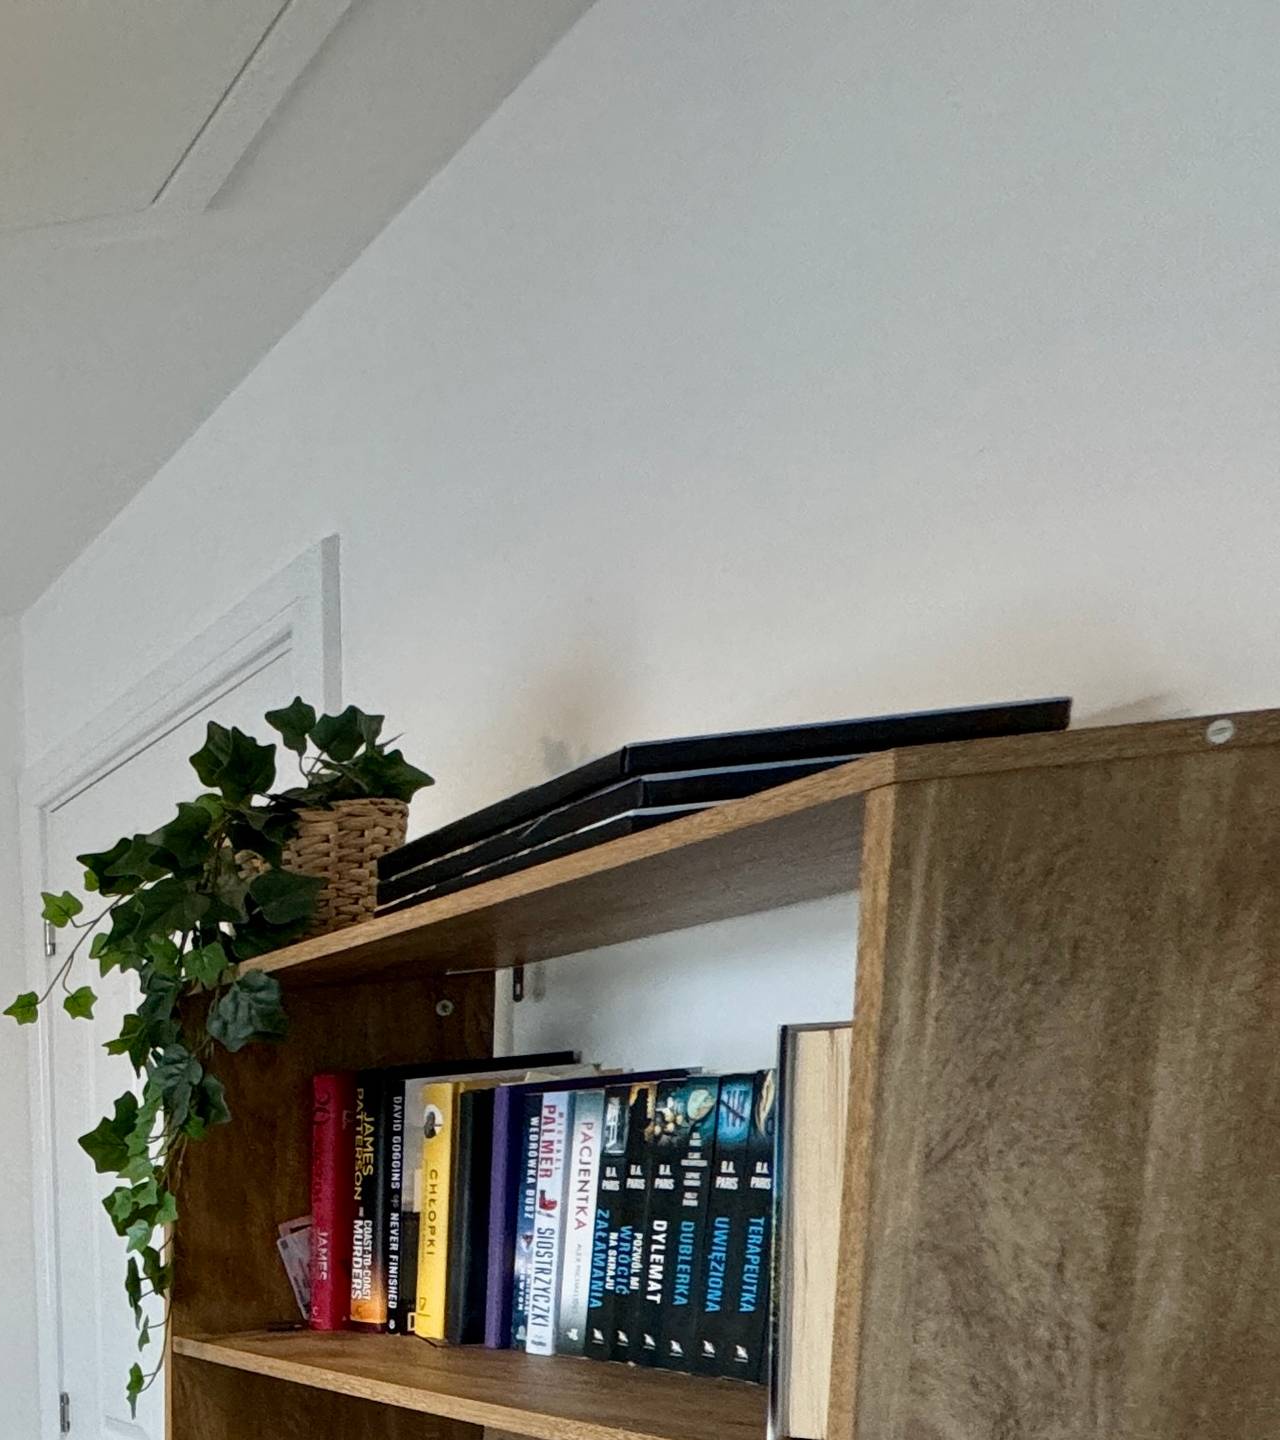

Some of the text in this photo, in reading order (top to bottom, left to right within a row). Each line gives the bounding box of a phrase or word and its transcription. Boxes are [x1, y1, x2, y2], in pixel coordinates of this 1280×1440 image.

[353, 1088, 365, 1200] PATTERSON
[361, 1116, 375, 1176] JAMES
[390, 1096, 403, 1190] DAVID GOGGINS
[538, 1104, 557, 1179] PALMER
[573, 1121, 595, 1231] PACJENTKA
[426, 1168, 438, 1256] CHŁOPKI
[351, 1220, 364, 1300] MURDERS
[363, 1219, 373, 1300] COAST-TO-COAST
[387, 1212, 400, 1310] NEVER FINISHED
[531, 1227, 556, 1328] SIOSTRZYCZKI
[589, 1208, 611, 1309] ZAŁAMANIA
[605, 1231, 619, 1291] NA SKRAJU
[615, 1225, 633, 1295] WRÓCIĆ
[646, 1219, 668, 1304] DYLEMAT
[673, 1221, 695, 1306] DUBLERKA
[705, 1216, 730, 1313] UWIĘZIONA
[739, 1216, 766, 1313] TERAPEUTKA
